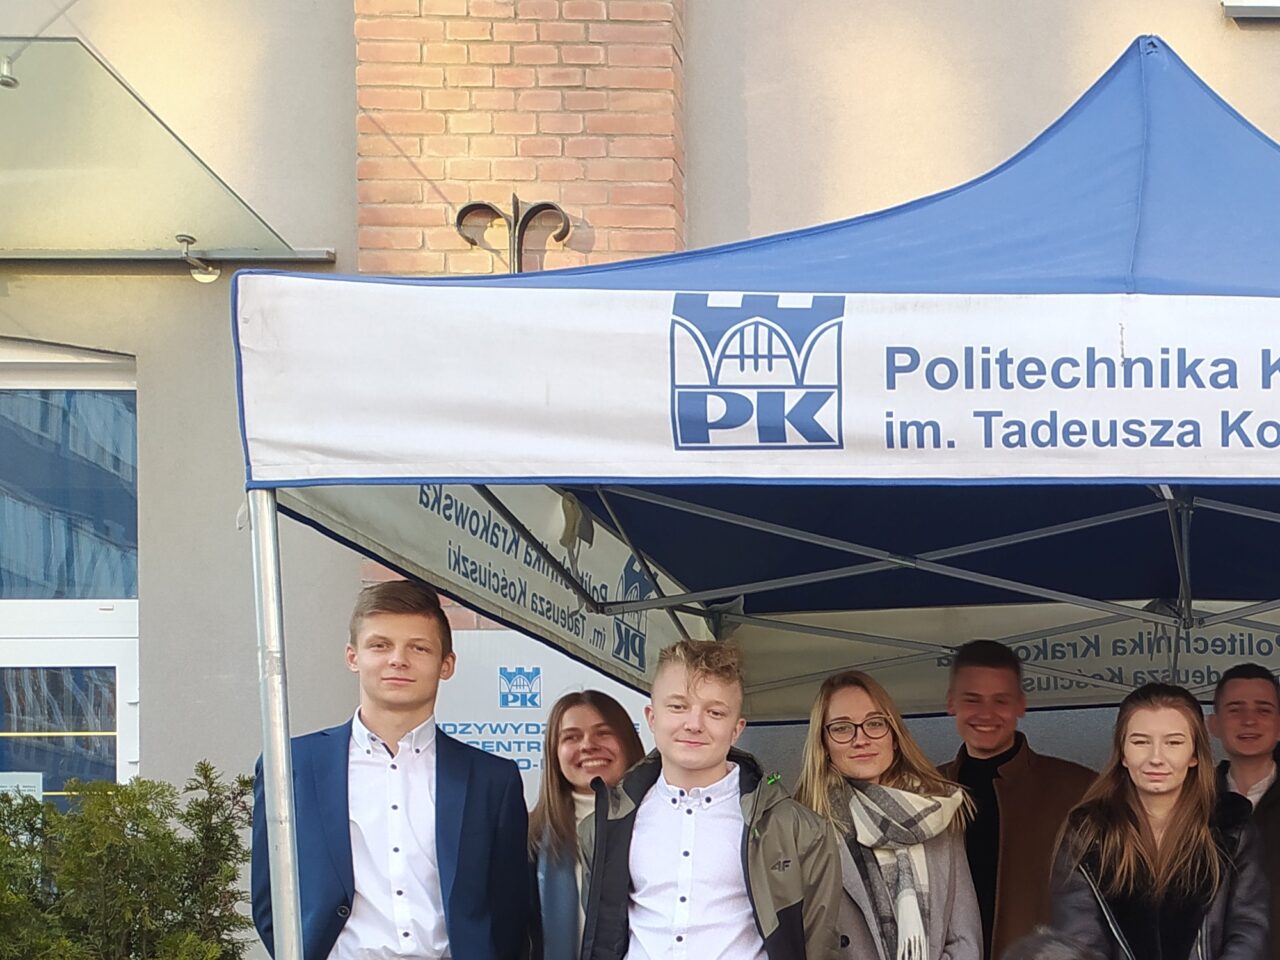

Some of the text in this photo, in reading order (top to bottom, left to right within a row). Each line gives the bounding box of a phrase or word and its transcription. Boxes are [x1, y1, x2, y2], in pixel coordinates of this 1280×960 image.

[886, 346, 1238, 390] Politechnika
[676, 391, 835, 445] PK
[885, 411, 955, 449] im.
[973, 411, 1201, 449] Tadeusza
[501, 691, 539, 707] PK
[438, 723, 546, 735] DZYWYD
[466, 740, 542, 753] ENTR
[770, 859, 791, 872] 4F
